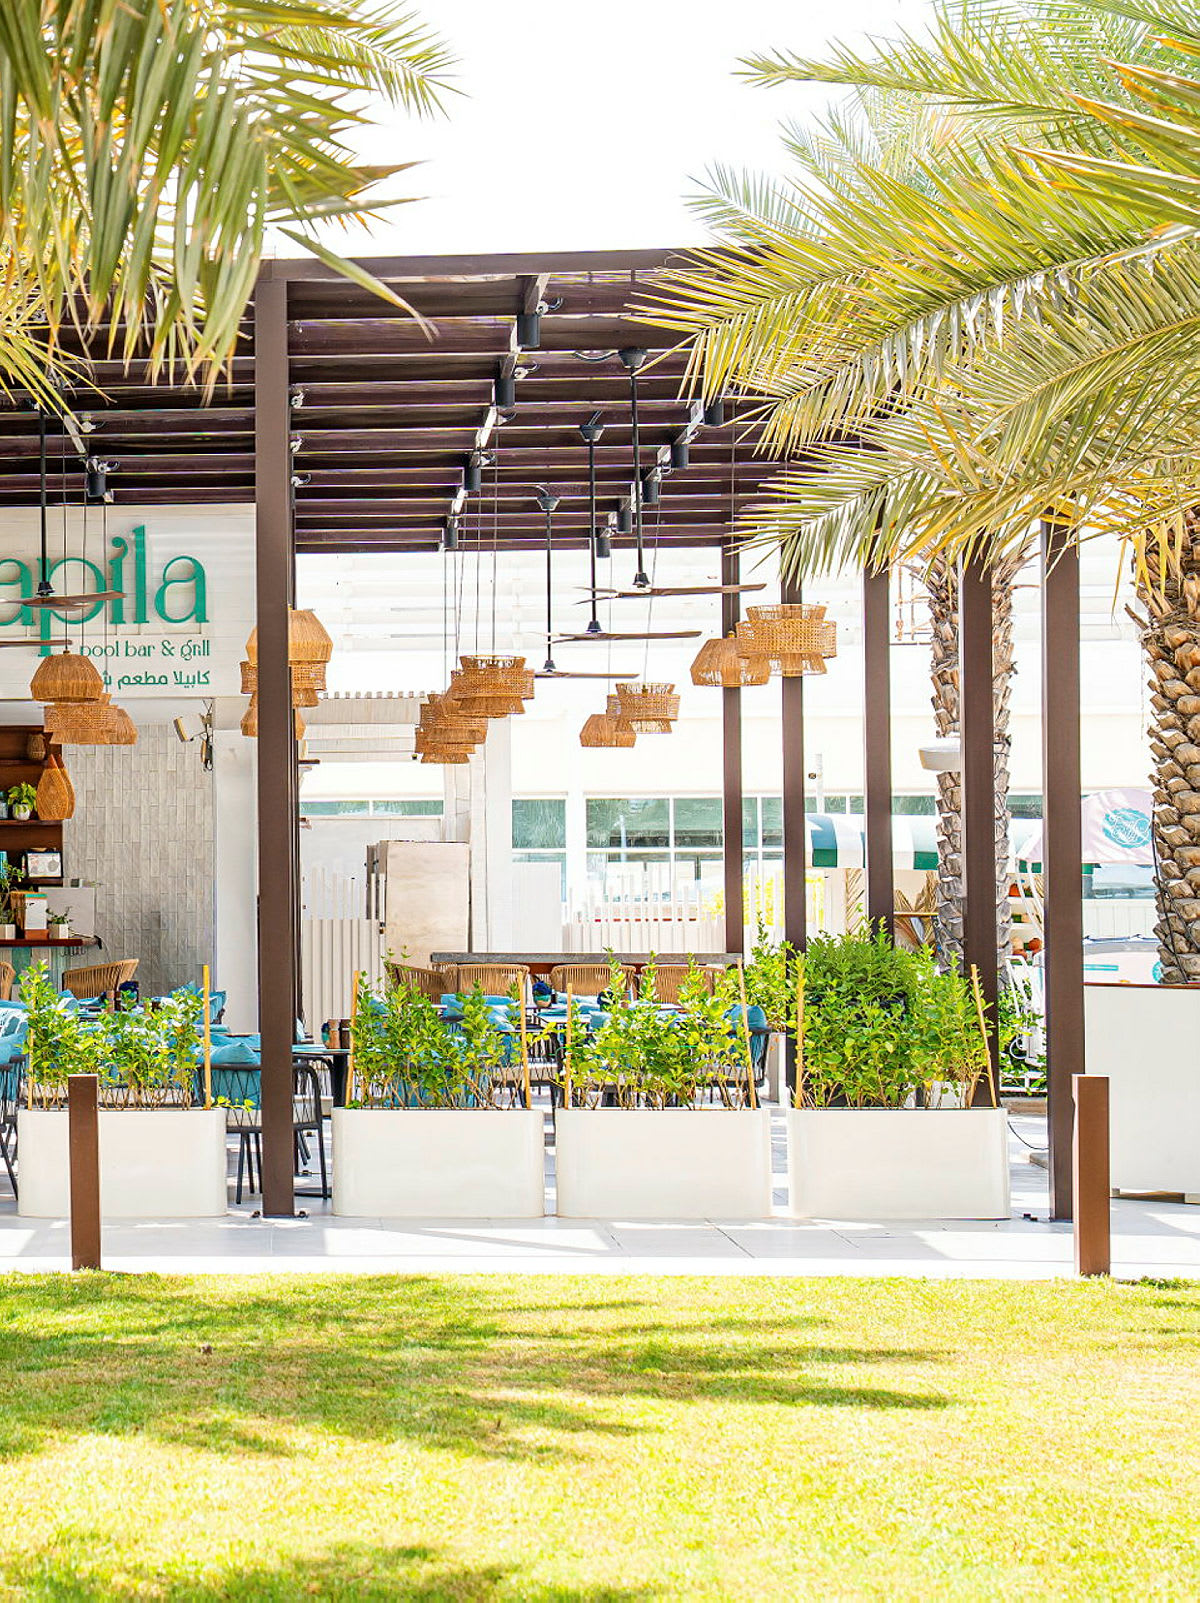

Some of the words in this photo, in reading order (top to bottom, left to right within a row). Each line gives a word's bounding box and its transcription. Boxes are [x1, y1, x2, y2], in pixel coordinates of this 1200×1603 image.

[80, 640, 120, 657] pool
[125, 640, 156, 657] bar
[161, 639, 175, 657] &
[180, 639, 210, 661] grill
[117, 671, 169, 690] مطعم
[173, 670, 210, 689] كابيلا
